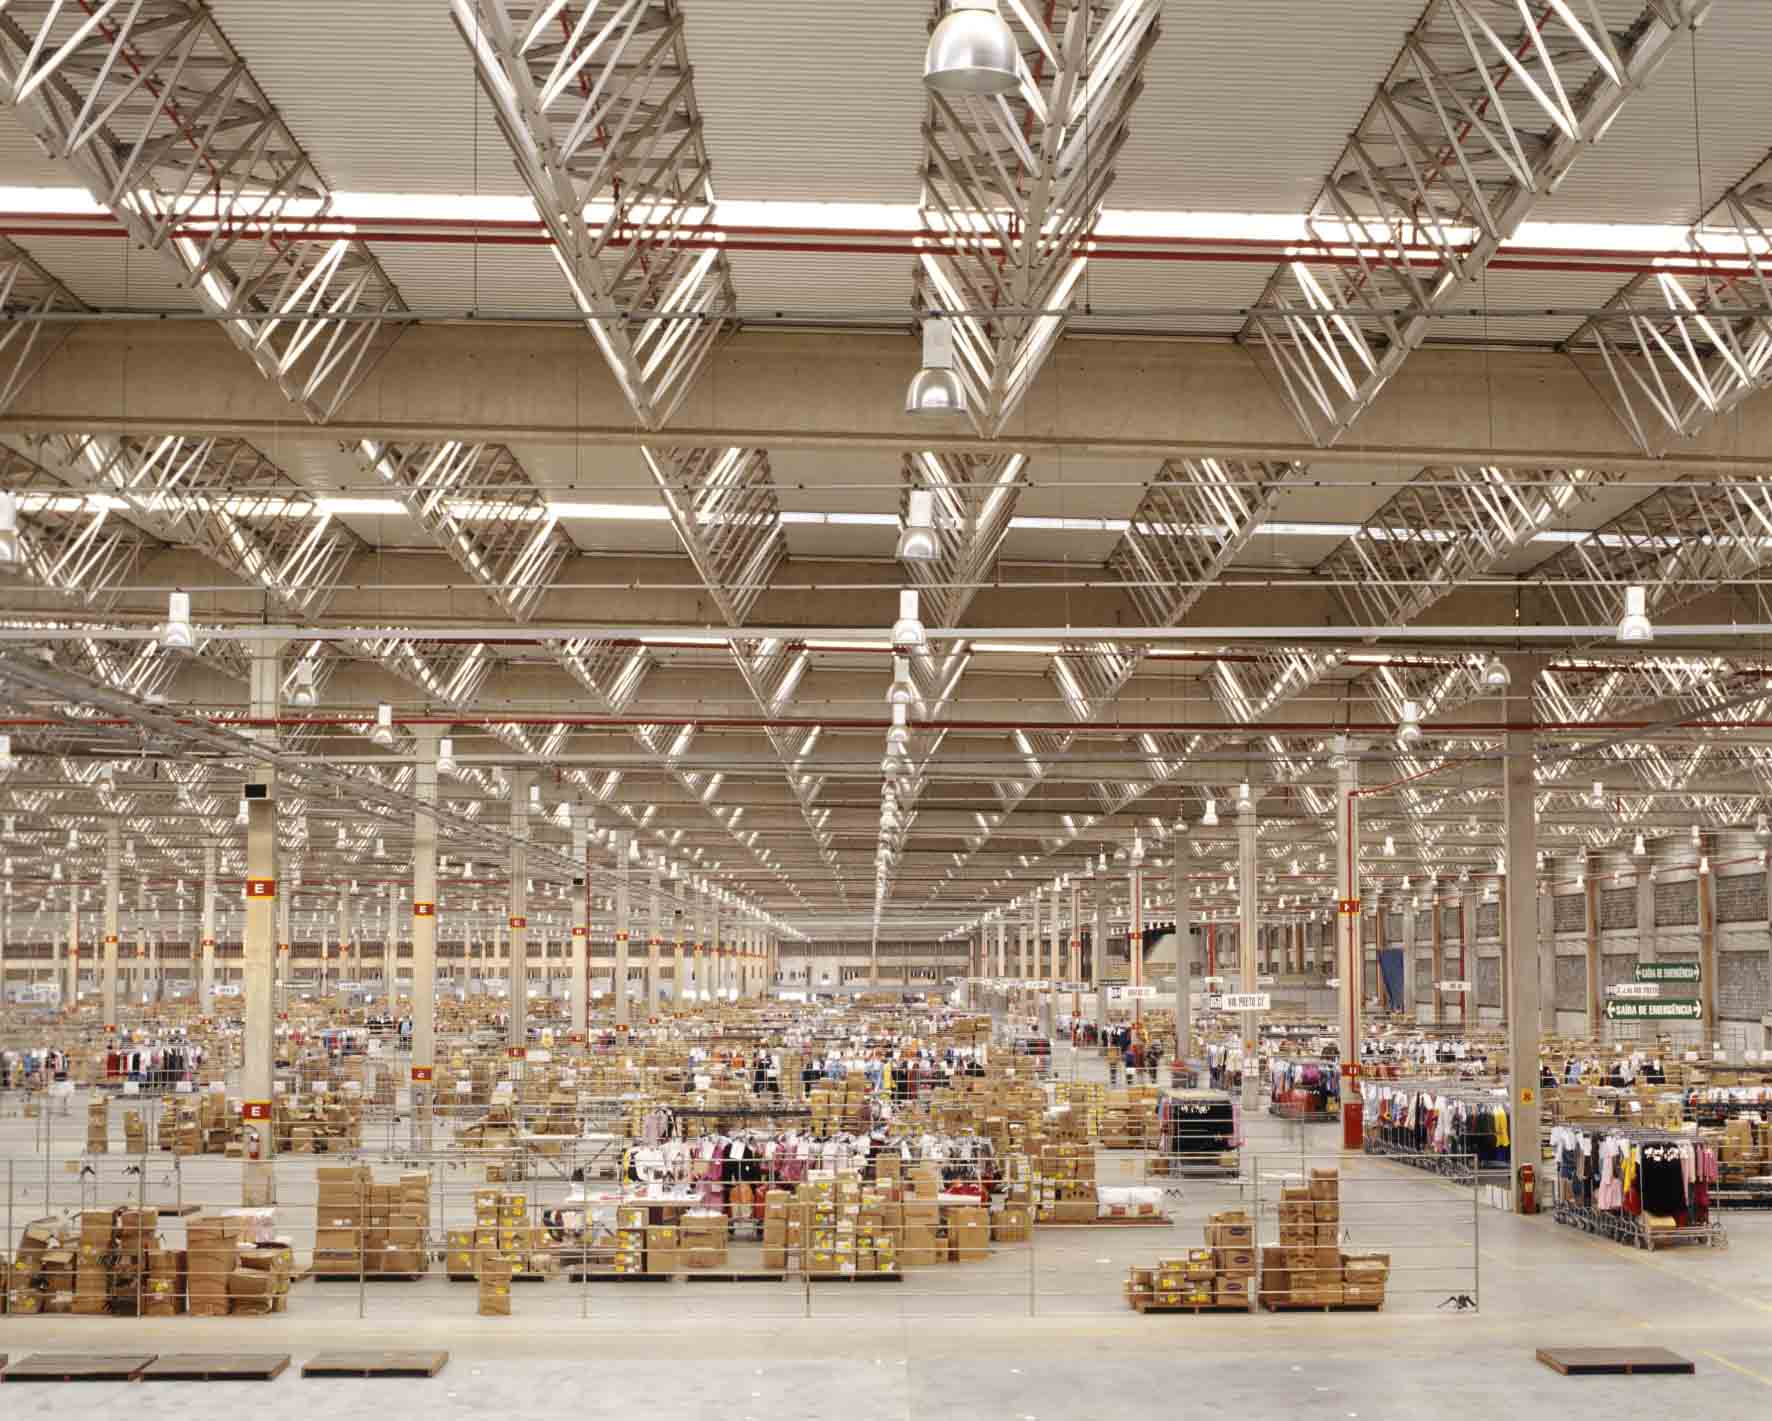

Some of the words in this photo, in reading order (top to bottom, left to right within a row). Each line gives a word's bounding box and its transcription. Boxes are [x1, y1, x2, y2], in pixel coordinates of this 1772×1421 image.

[255, 883, 265, 894] E
[1616, 1004, 1637, 1015] SAÍDA
[1638, 1005, 1648, 1015] DE
[251, 1106, 262, 1117] E
